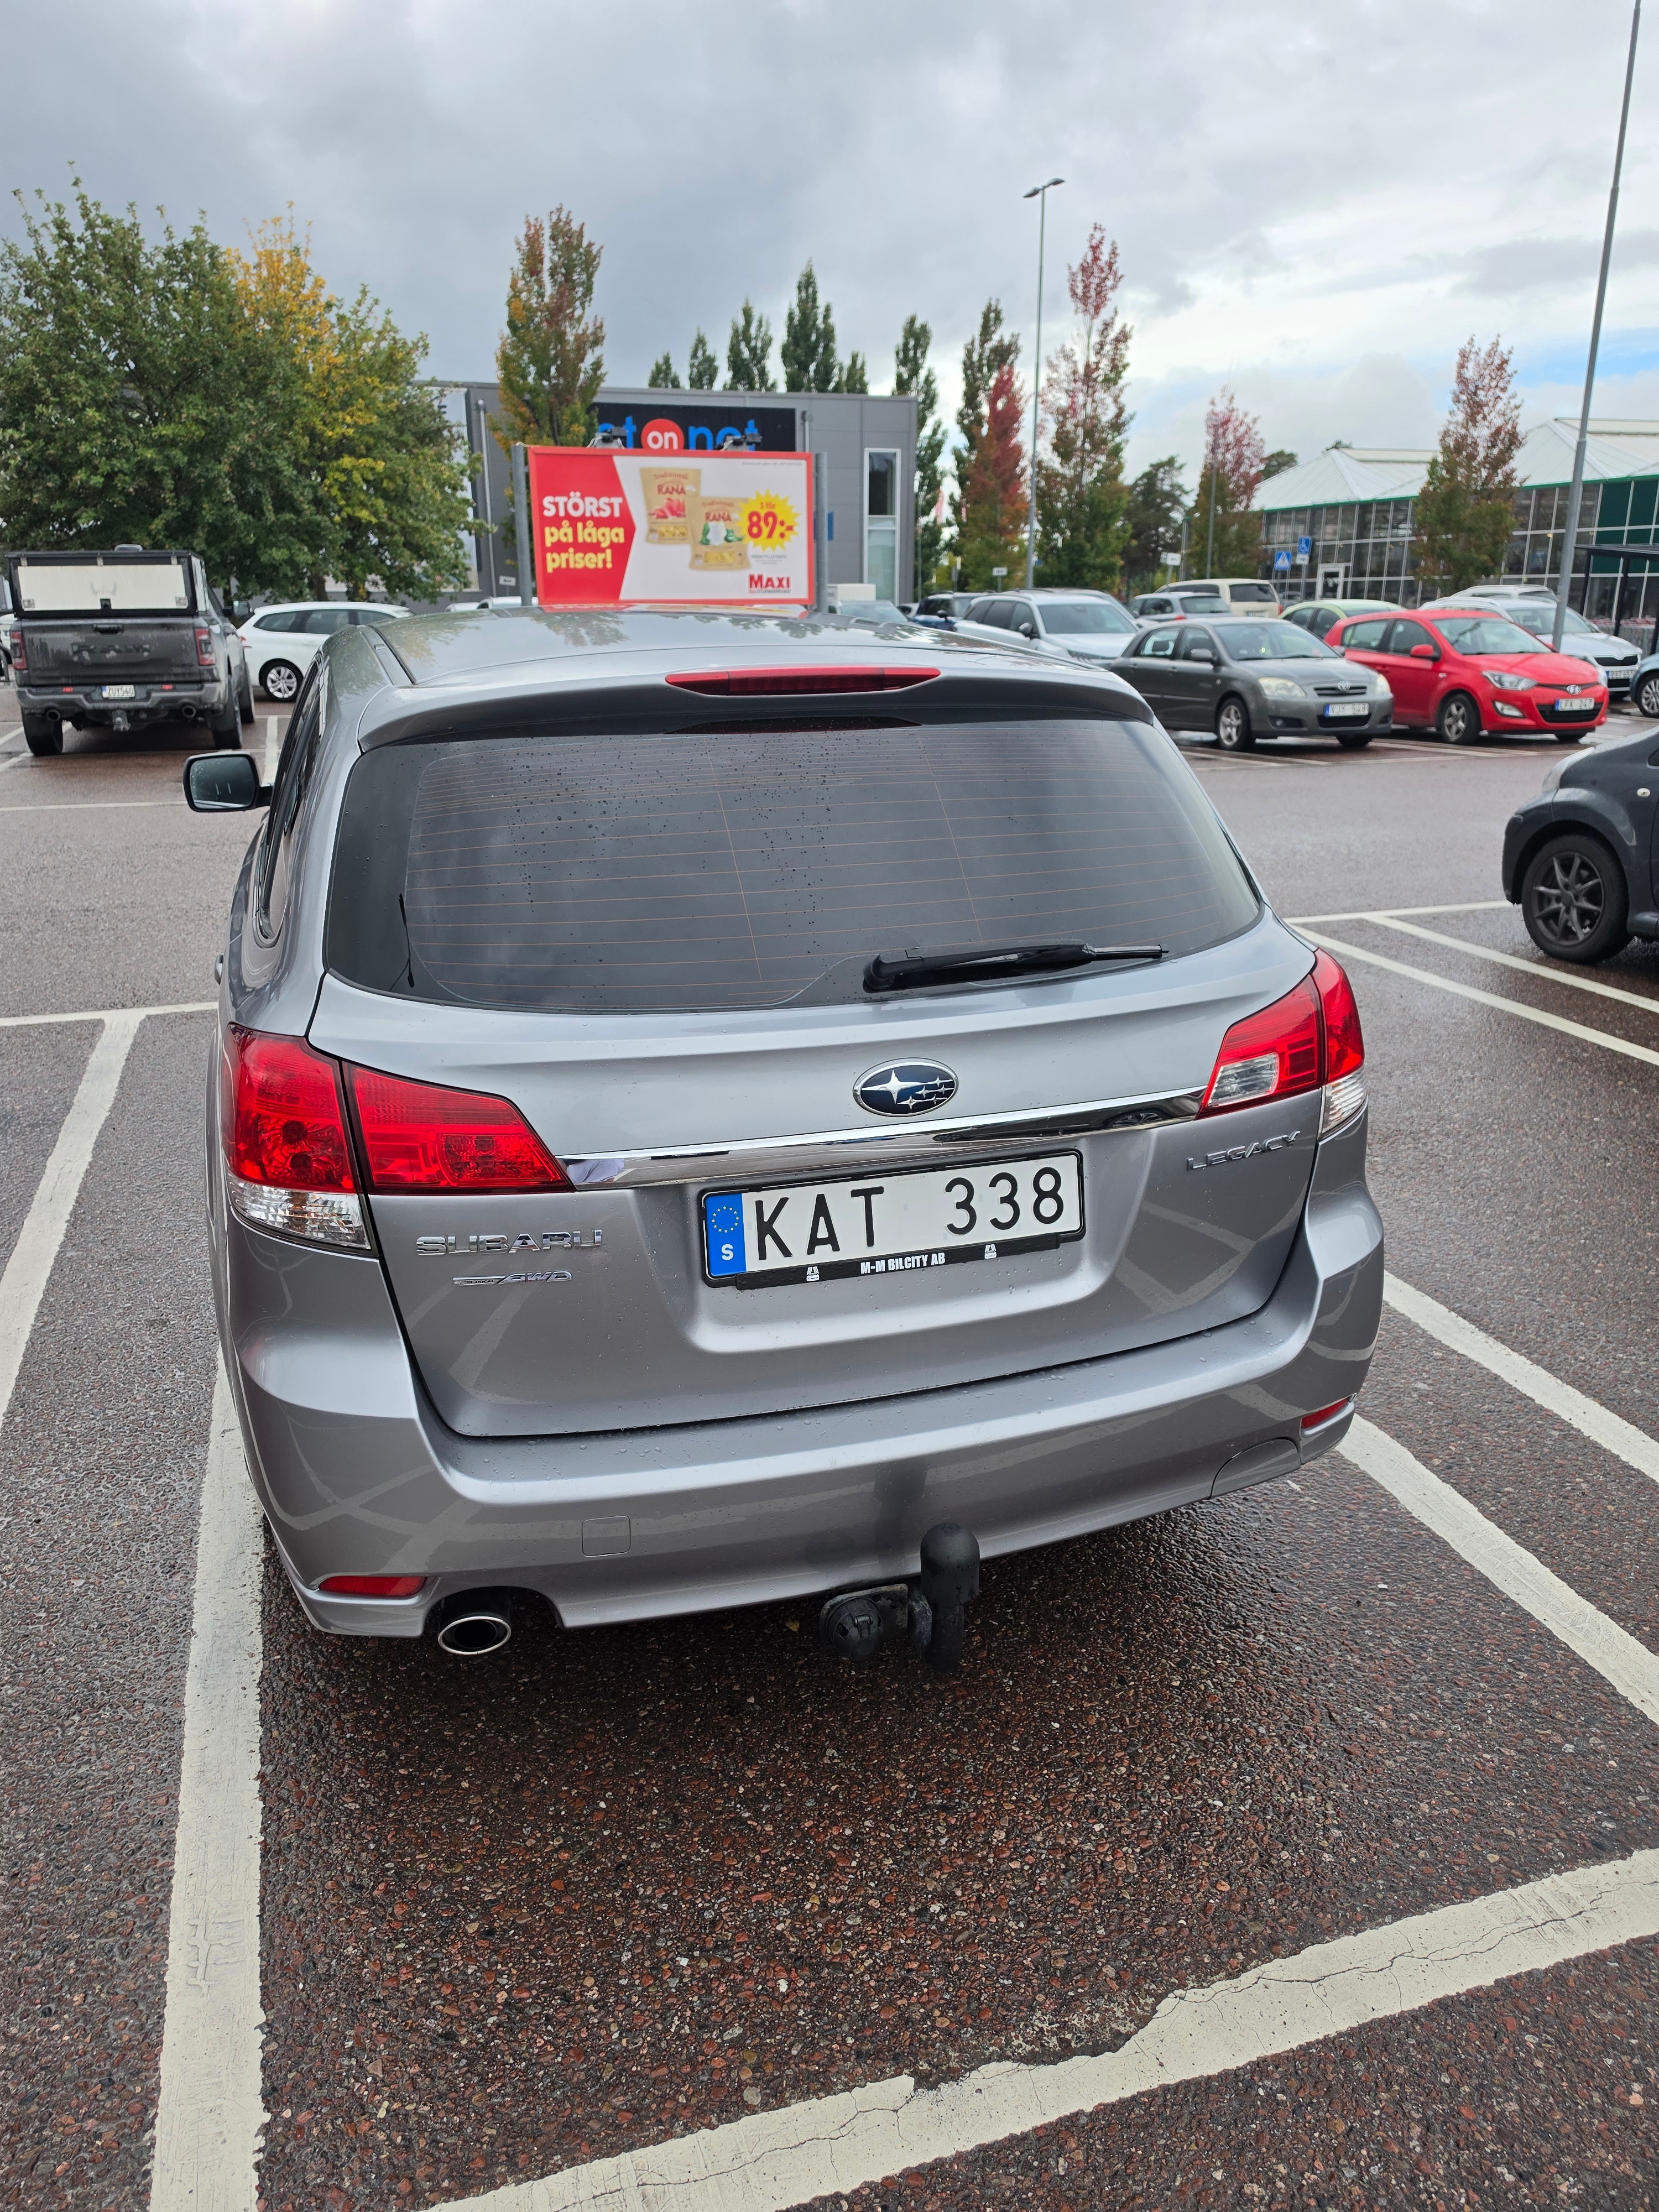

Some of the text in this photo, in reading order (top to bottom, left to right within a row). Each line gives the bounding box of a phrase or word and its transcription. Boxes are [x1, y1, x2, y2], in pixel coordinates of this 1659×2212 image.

[646, 430, 679, 450] on
[656, 484, 687, 495] RANA
[542, 491, 624, 518] STÖRST
[705, 511, 733, 522] RANA
[544, 519, 625, 548] på låga
[748, 510, 794, 539] 89:-
[546, 547, 613, 573] priser!
[749, 573, 790, 588] MAXI
[1187, 1130, 1301, 1171] LEGACY
[754, 1166, 1065, 1261] KAT 338
[416, 1229, 603, 1256] SUBARU
[721, 1244, 734, 1261] S
[860, 1252, 946, 1274] M-M BILCITY AB
[498, 1270, 573, 1285] AWD
